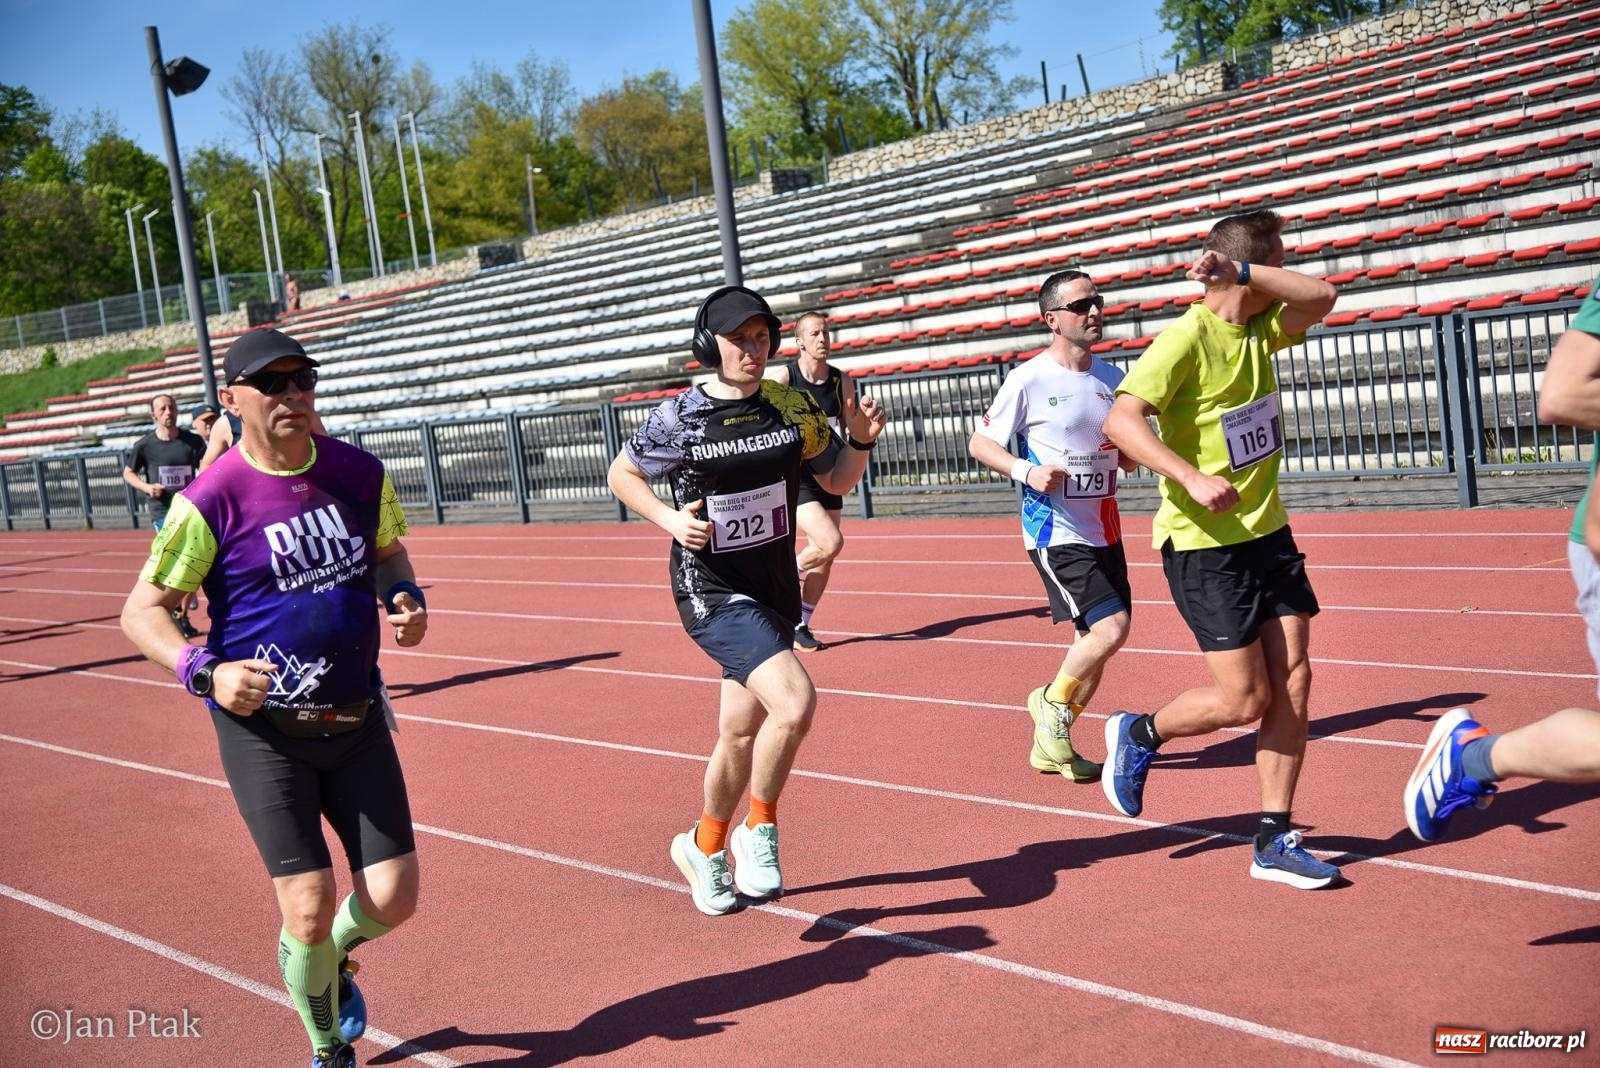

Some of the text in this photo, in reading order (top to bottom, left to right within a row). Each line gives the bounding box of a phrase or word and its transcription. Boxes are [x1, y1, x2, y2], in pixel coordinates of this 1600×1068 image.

[691, 426, 799, 461] RUNMAGEDDON
[1240, 426, 1268, 455] 116
[166, 475, 181, 485] 118
[1075, 472, 1104, 491] 179
[741, 495, 751, 503] BEZ
[263, 503, 354, 577] RUN
[725, 514, 766, 541] 212
